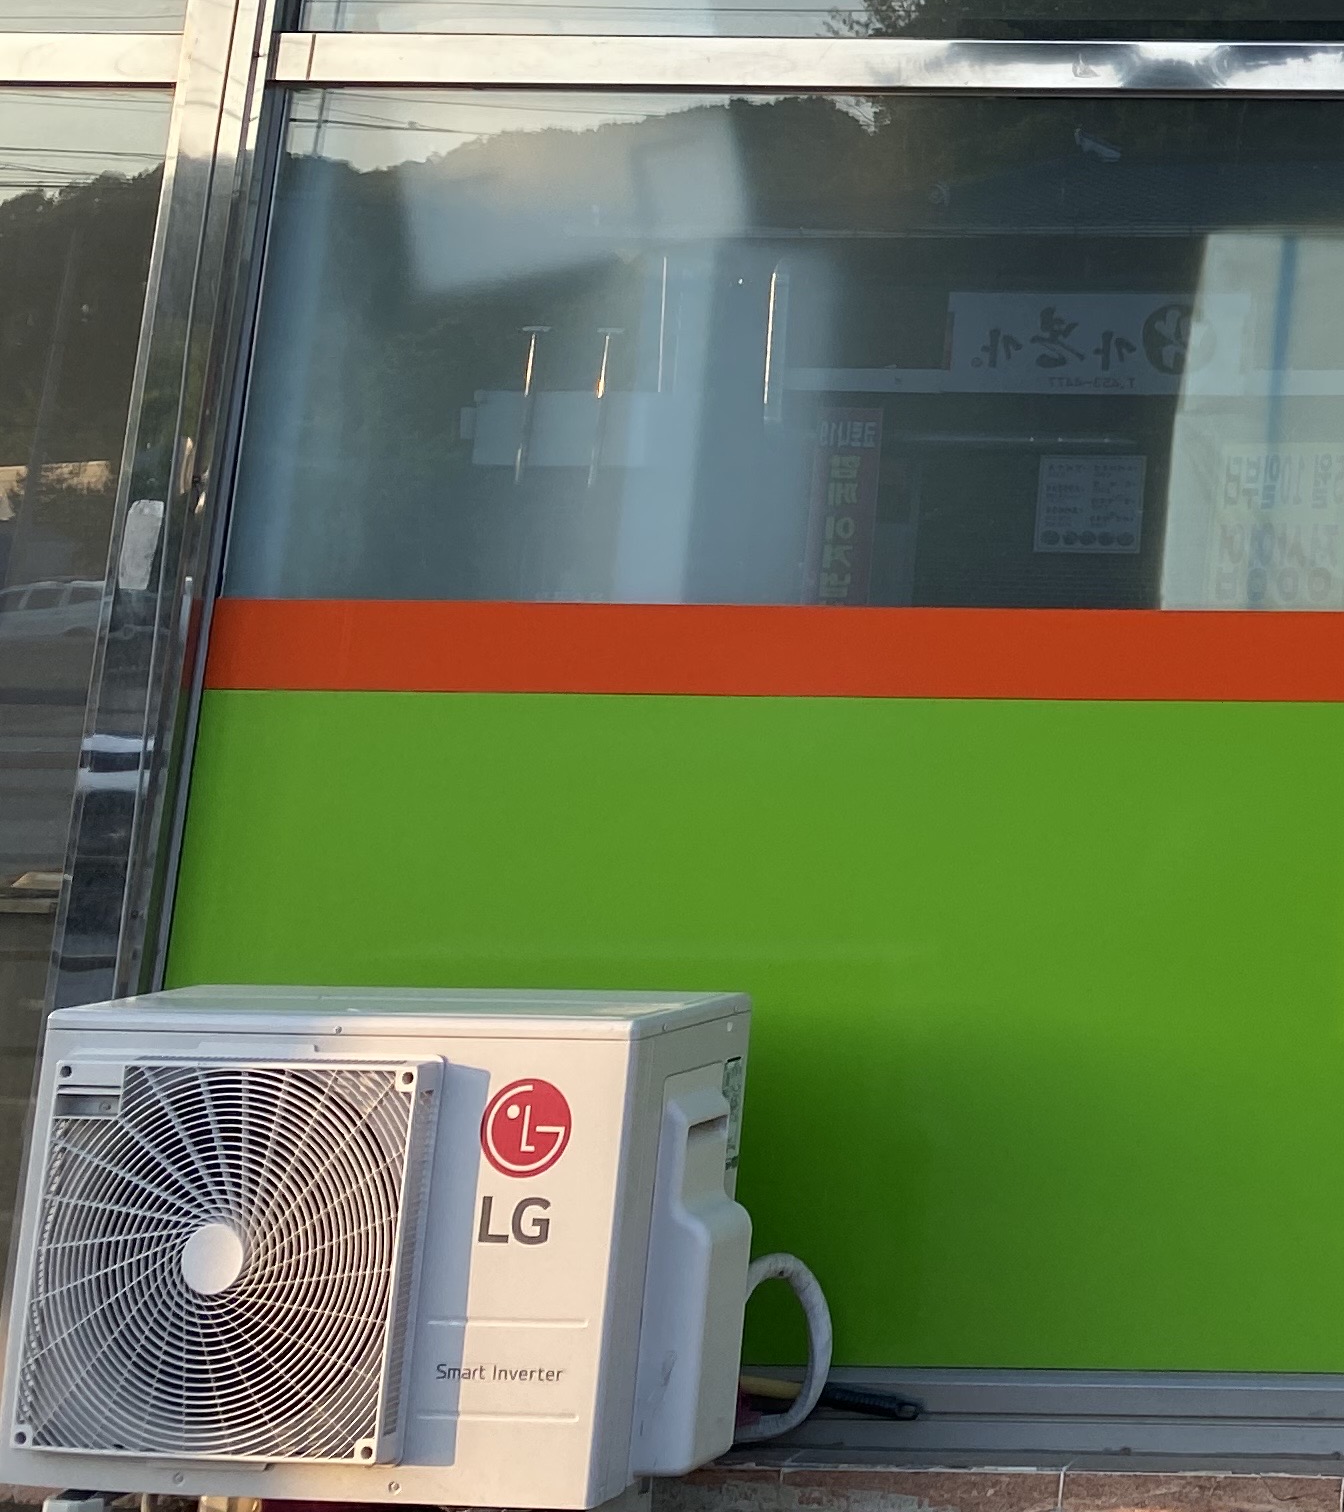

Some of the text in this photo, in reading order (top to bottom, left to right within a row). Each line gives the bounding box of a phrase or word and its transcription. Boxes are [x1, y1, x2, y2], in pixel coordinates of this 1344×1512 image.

[477, 1195, 551, 1246] LG
[436, 1363, 564, 1382] Smart Inverter
